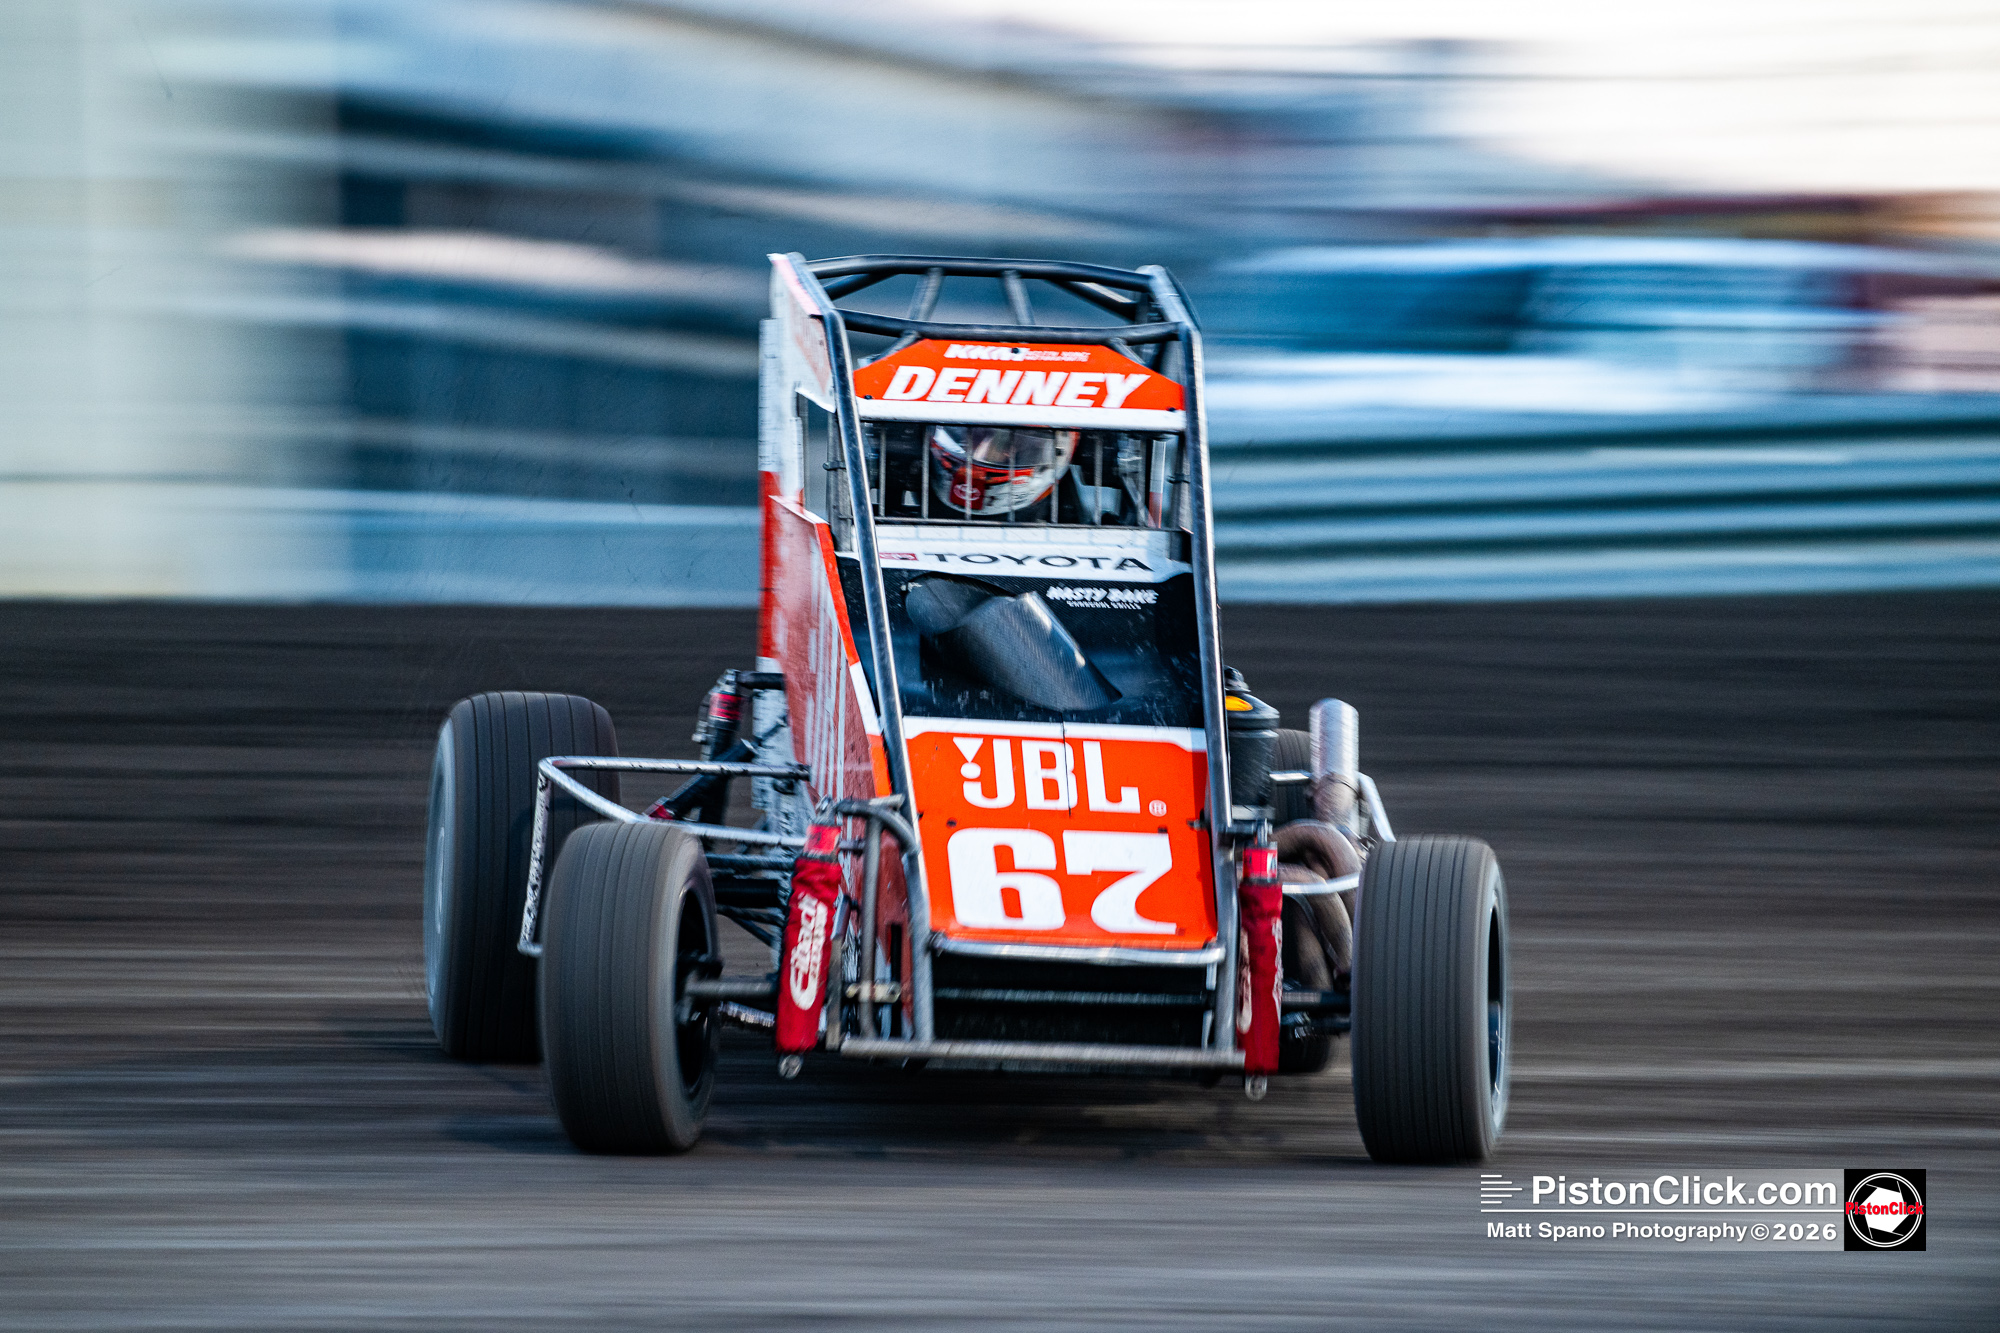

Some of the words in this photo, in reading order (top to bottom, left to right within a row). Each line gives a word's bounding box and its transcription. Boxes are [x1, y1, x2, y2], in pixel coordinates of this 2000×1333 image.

[882, 365, 1152, 409] DENNEY
[923, 553, 1155, 573] TOYOTA
[953, 737, 1141, 814] JBL
[947, 827, 1177, 936] 67
